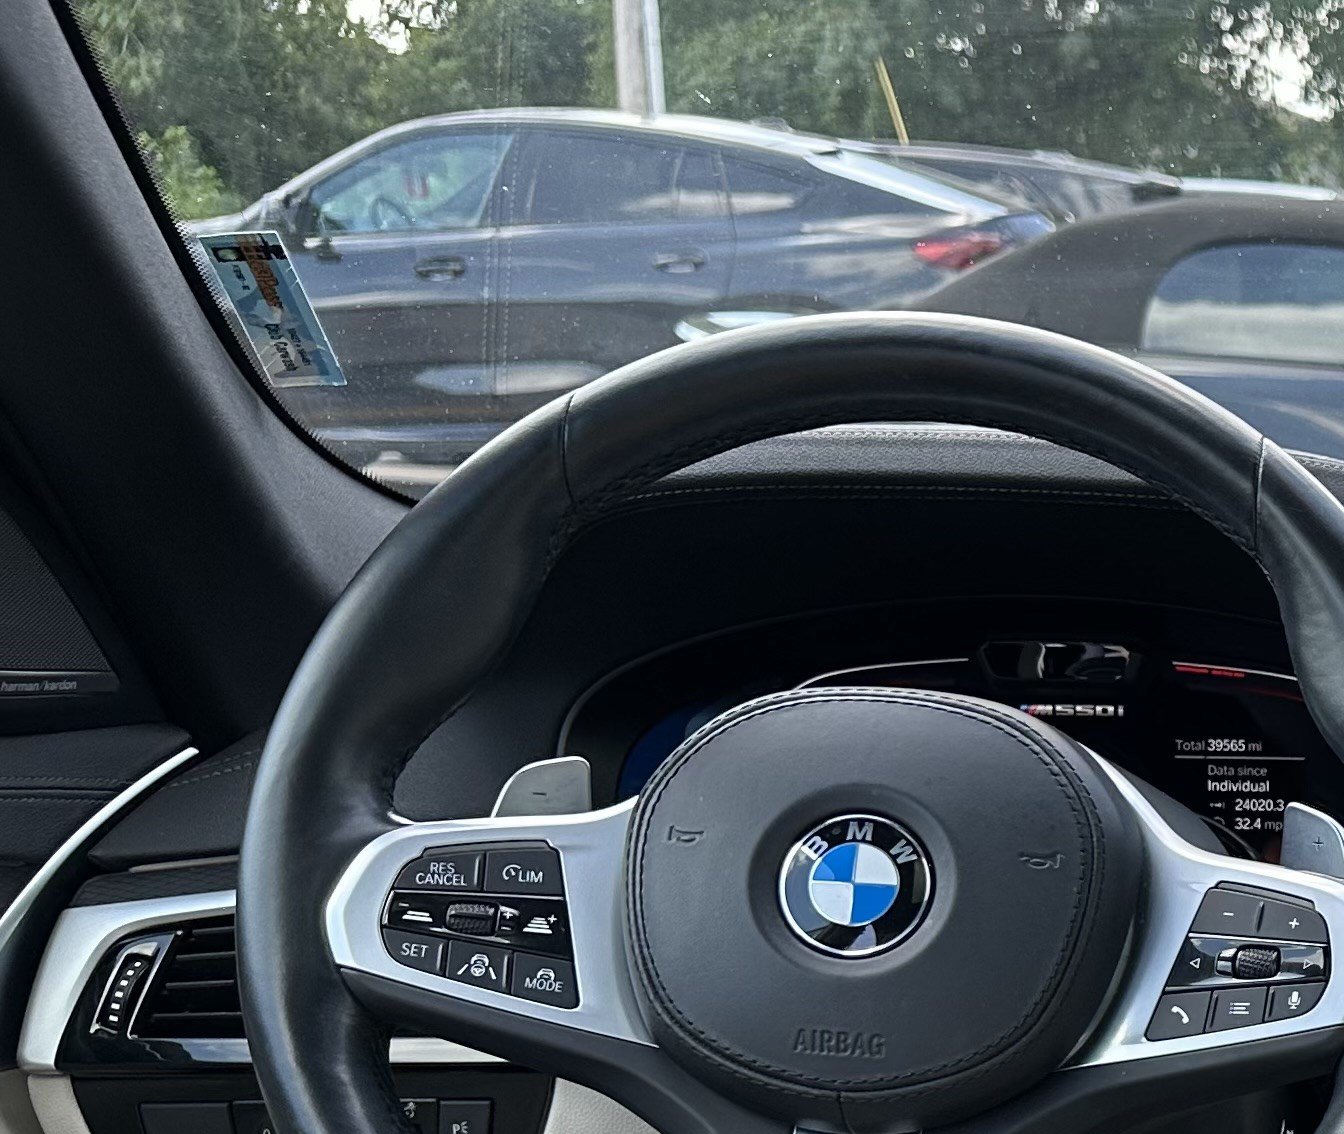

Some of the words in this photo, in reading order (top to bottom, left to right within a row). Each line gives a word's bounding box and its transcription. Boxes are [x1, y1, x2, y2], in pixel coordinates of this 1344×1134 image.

[1176, 738, 1206, 752] Total
[1207, 738, 1246, 752] 39565
[1248, 740, 1263, 752] mi
[1207, 764, 1235, 777] Data
[1237, 765, 1268, 777] since
[1207, 779, 1270, 794] Individual
[1234, 818, 1262, 831] 32.4
[801, 821, 918, 864] BMW
[430, 862, 455, 874] RES
[415, 873, 468, 887] CANCEL
[519, 870, 544, 884] LIM
[401, 942, 429, 959] SET
[524, 977, 564, 993] MODE
[794, 1028, 887, 1059] AIRBAG
